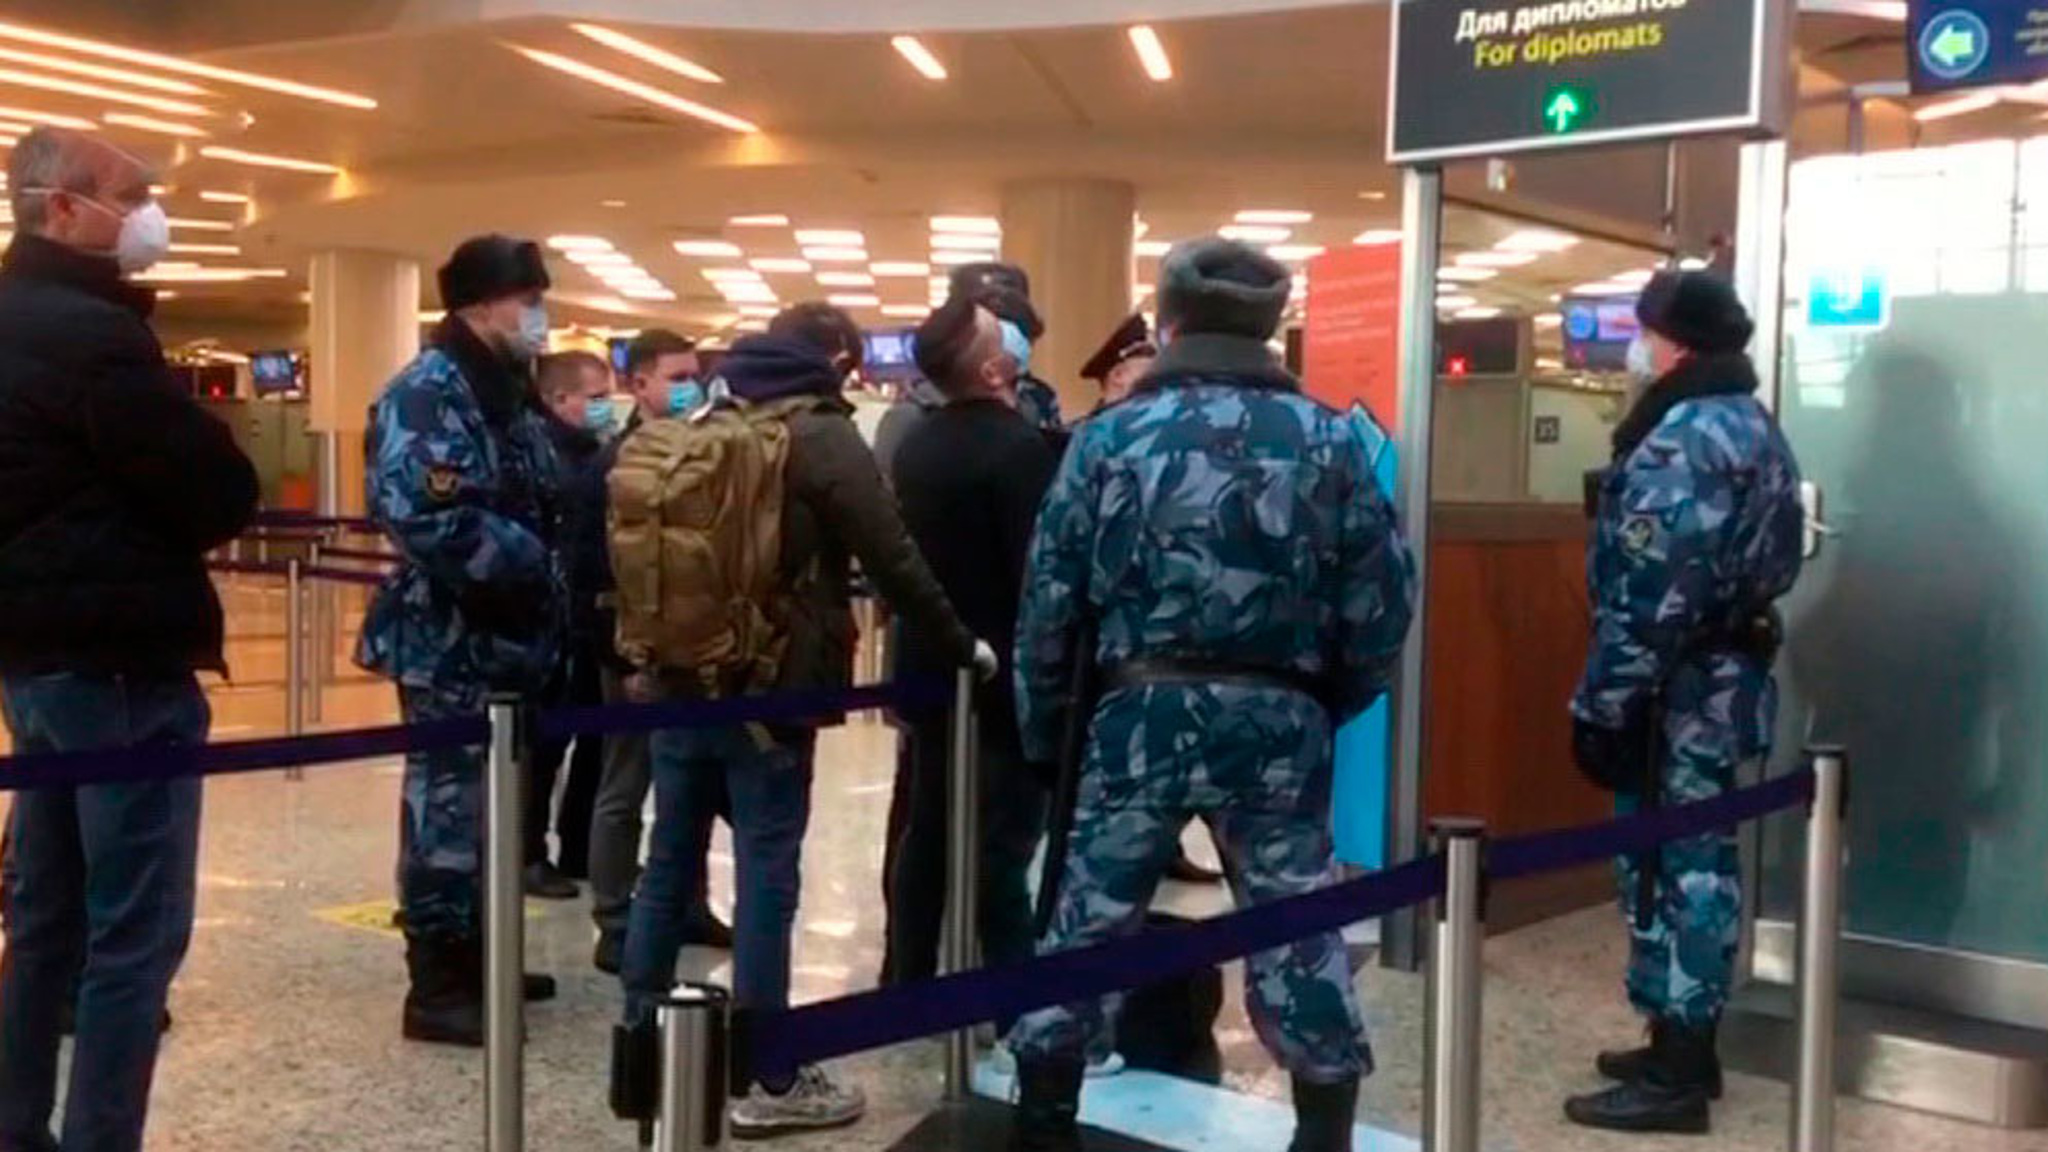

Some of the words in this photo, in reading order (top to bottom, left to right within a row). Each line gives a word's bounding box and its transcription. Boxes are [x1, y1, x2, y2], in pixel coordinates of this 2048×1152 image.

[1454, 9, 1508, 43] Для
[1474, 39, 1517, 67] For
[1522, 22, 1663, 64] diplomats
